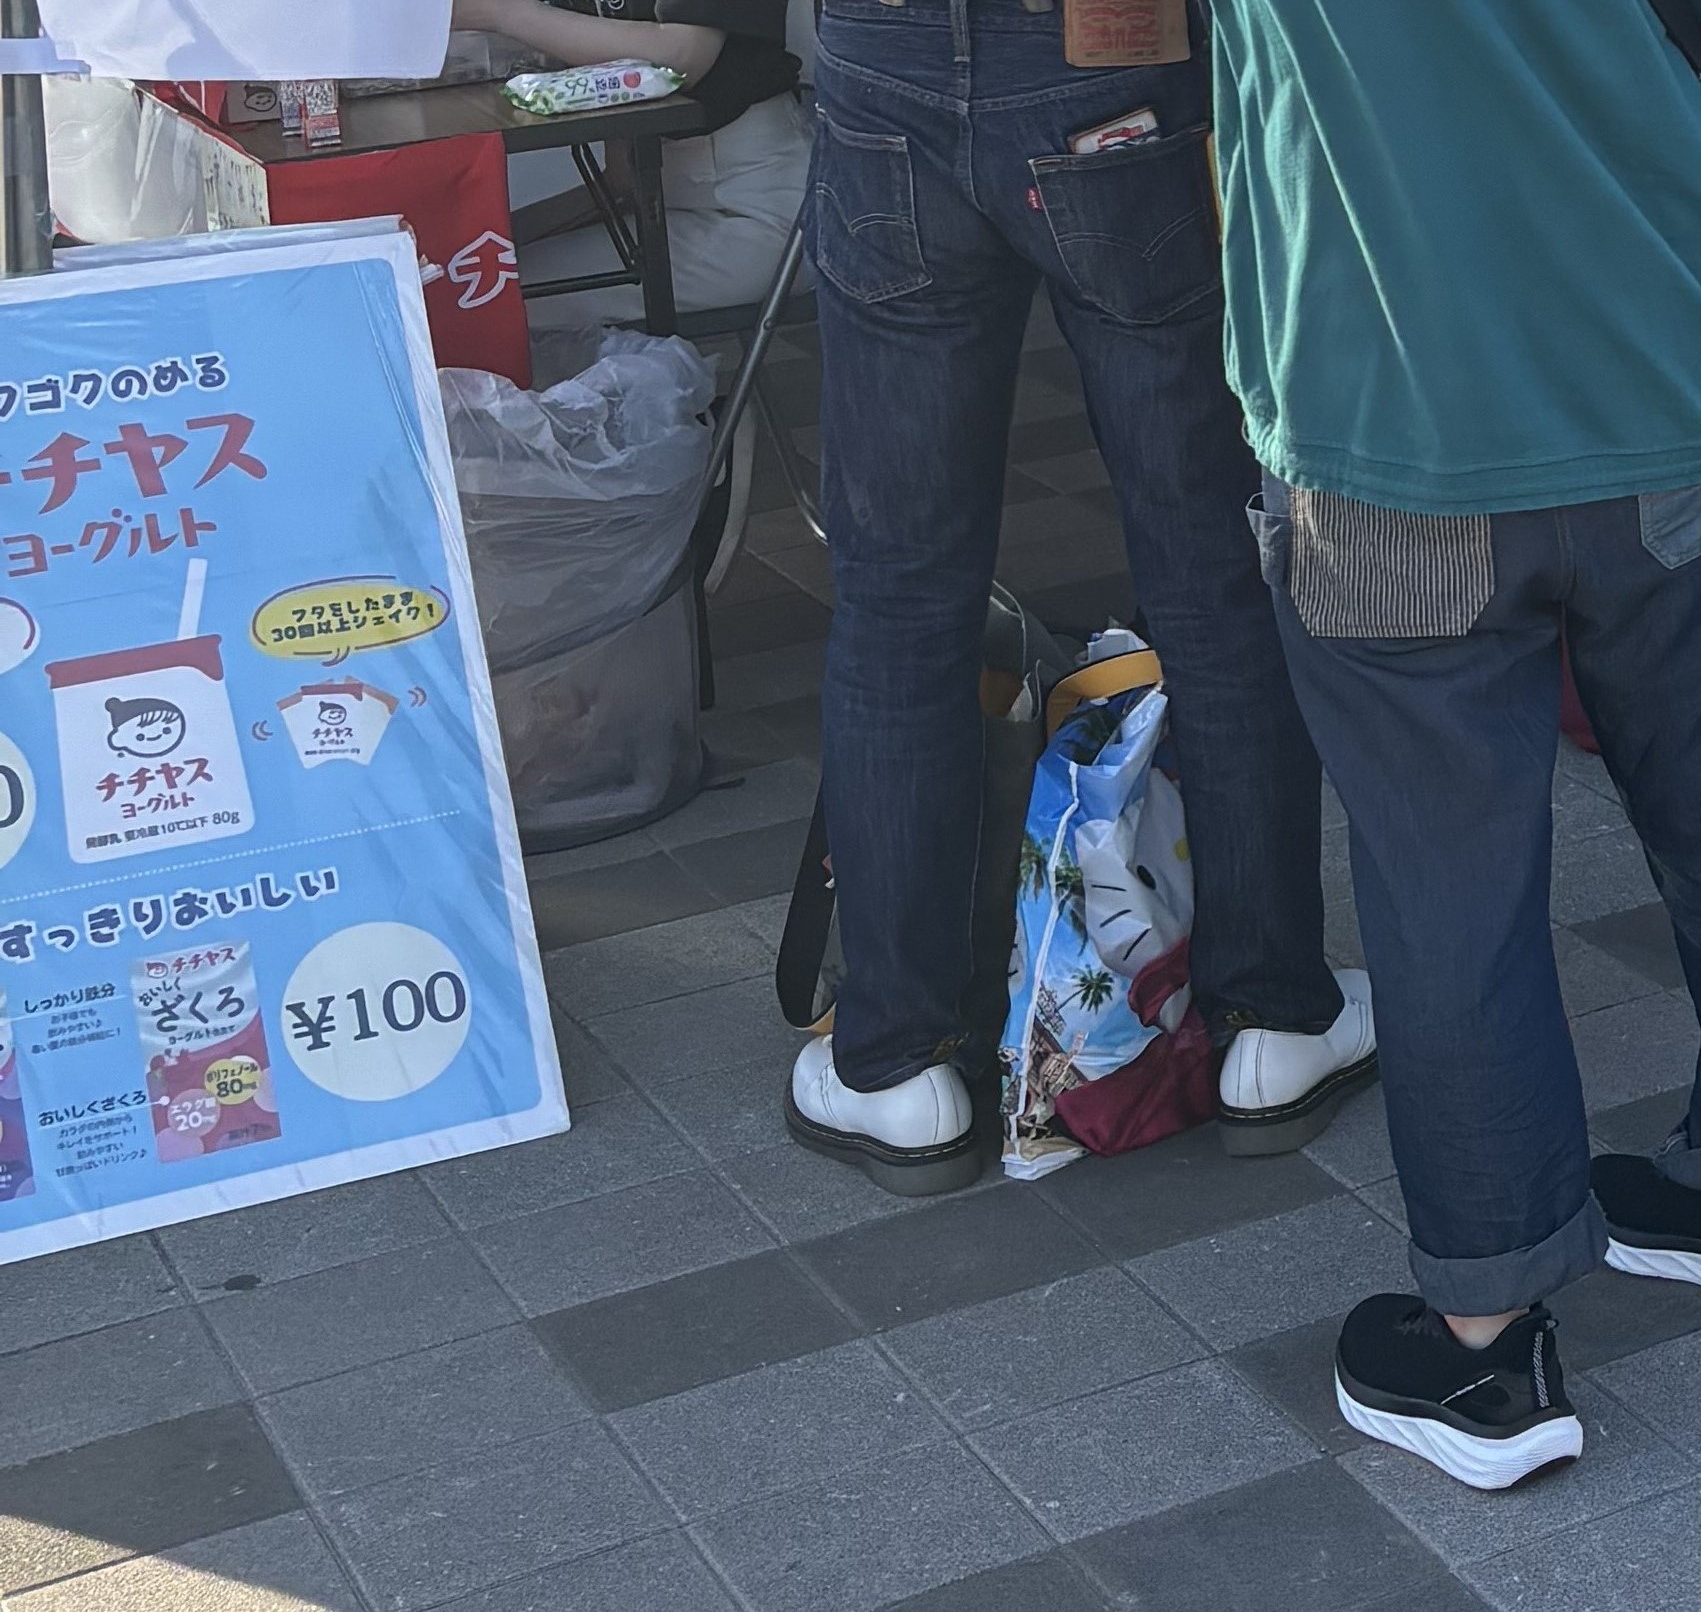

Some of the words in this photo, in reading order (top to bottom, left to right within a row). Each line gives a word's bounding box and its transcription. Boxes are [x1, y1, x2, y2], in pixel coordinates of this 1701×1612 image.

[0, 412, 268, 515] チヤス
[3, 507, 218, 578] ヨーグルト
[292, 591, 414, 623] フタをしたまま
[95, 757, 214, 803] チチヤス
[120, 791, 195, 819] ヨーグルト
[212, 810, 240, 826] 80g
[1, 869, 338, 959] すっきりおいしい
[172, 946, 237, 973] チチヤス
[24, 982, 116, 1014] しっかり鉄分
[152, 986, 245, 1033] ざくろ
[285, 969, 467, 1052] ¥100
[38, 1090, 147, 1127] おいしくざくろ
